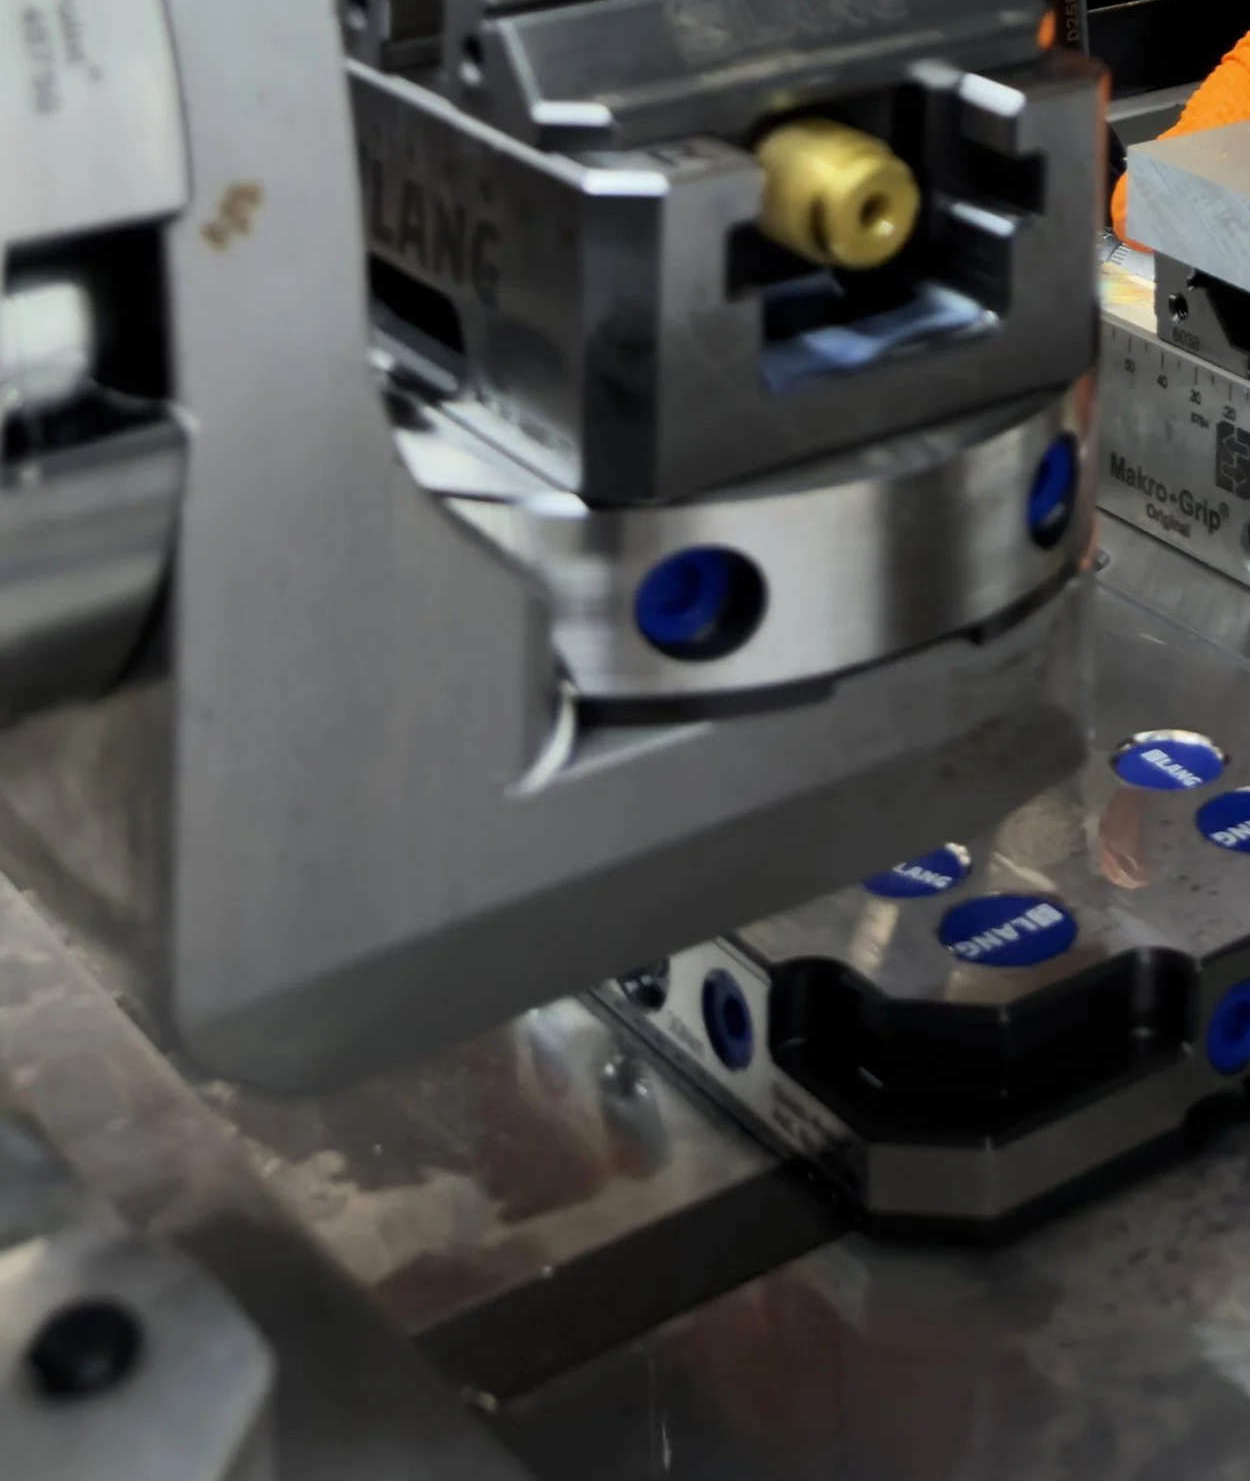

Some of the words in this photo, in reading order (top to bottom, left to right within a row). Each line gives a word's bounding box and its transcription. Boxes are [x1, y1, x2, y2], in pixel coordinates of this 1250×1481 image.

[371, 157, 498, 308] LANG
[1156, 374, 1168, 390] 40
[1146, 503, 1191, 538] Original
[1156, 758, 1202, 787] LANG
[954, 916, 1039, 959] LANG
